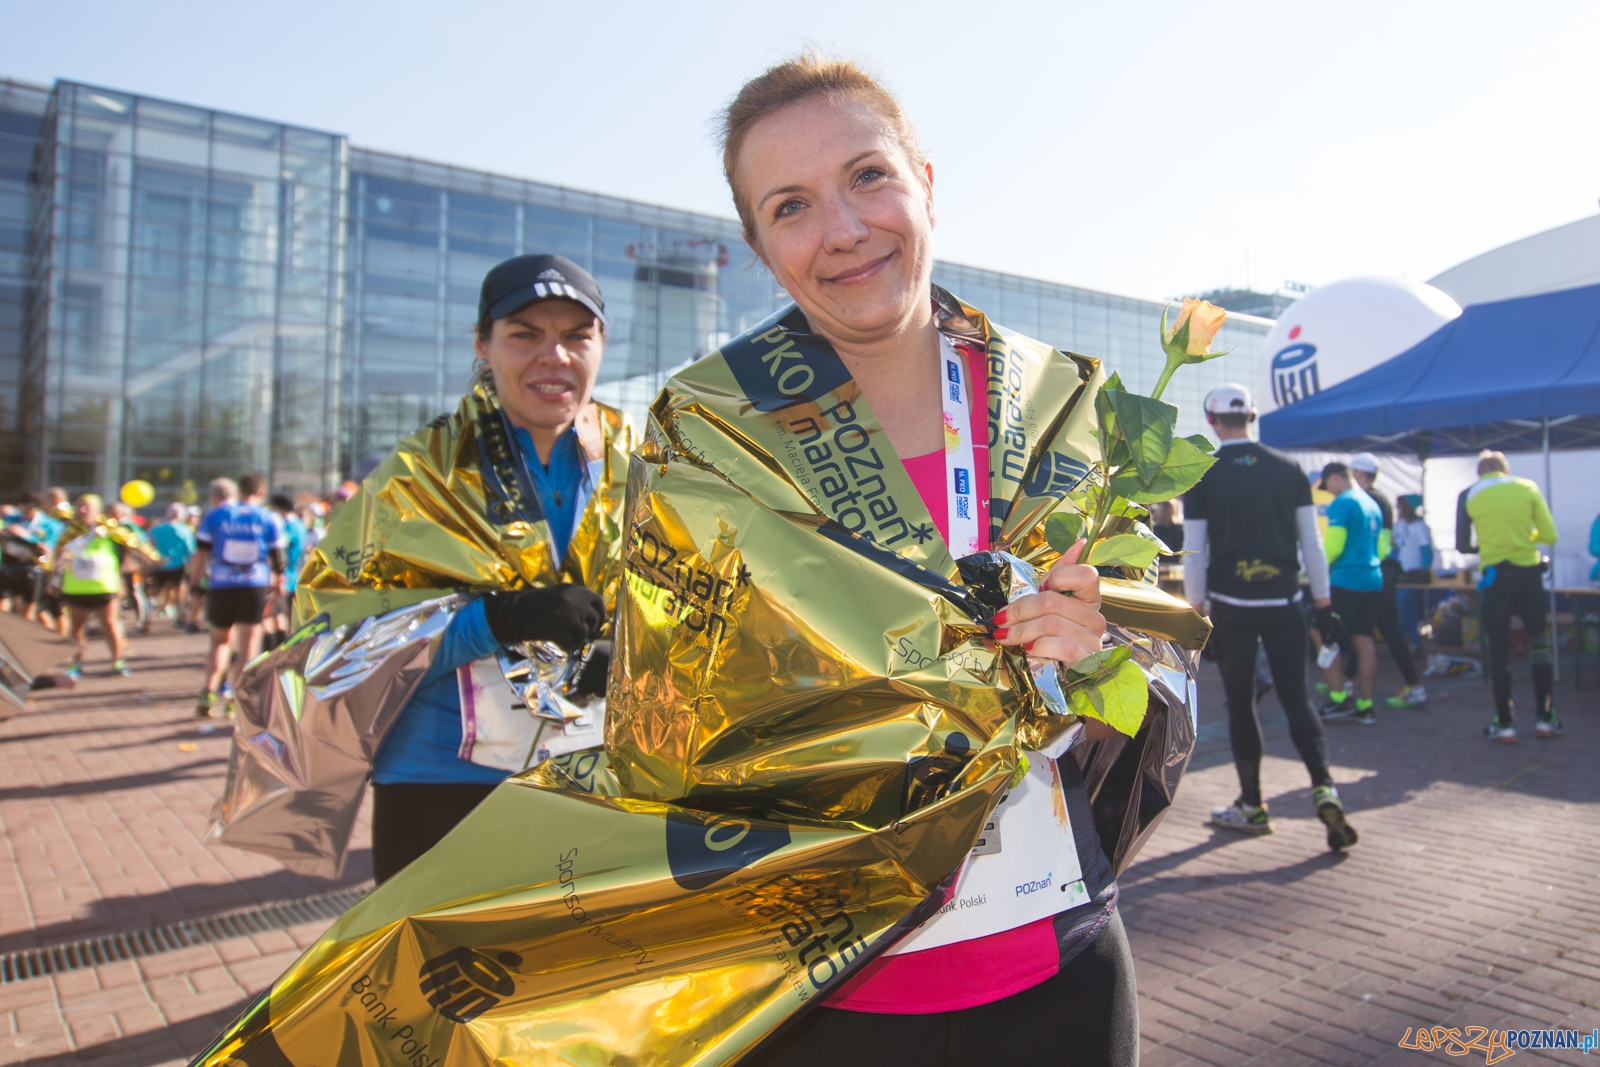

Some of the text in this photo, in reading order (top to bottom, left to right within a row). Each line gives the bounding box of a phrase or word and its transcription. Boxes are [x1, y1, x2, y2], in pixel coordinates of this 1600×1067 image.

[750, 326, 815, 395] PKO
[1001, 349, 1026, 484] maraton
[783, 439, 811, 486] Macieja
[959, 479, 967, 493] PKO
[555, 847, 593, 925] Sponsor
[959, 893, 987, 910] Polski
[768, 936, 810, 1002] Frankiew
[351, 974, 398, 1030] Bank
